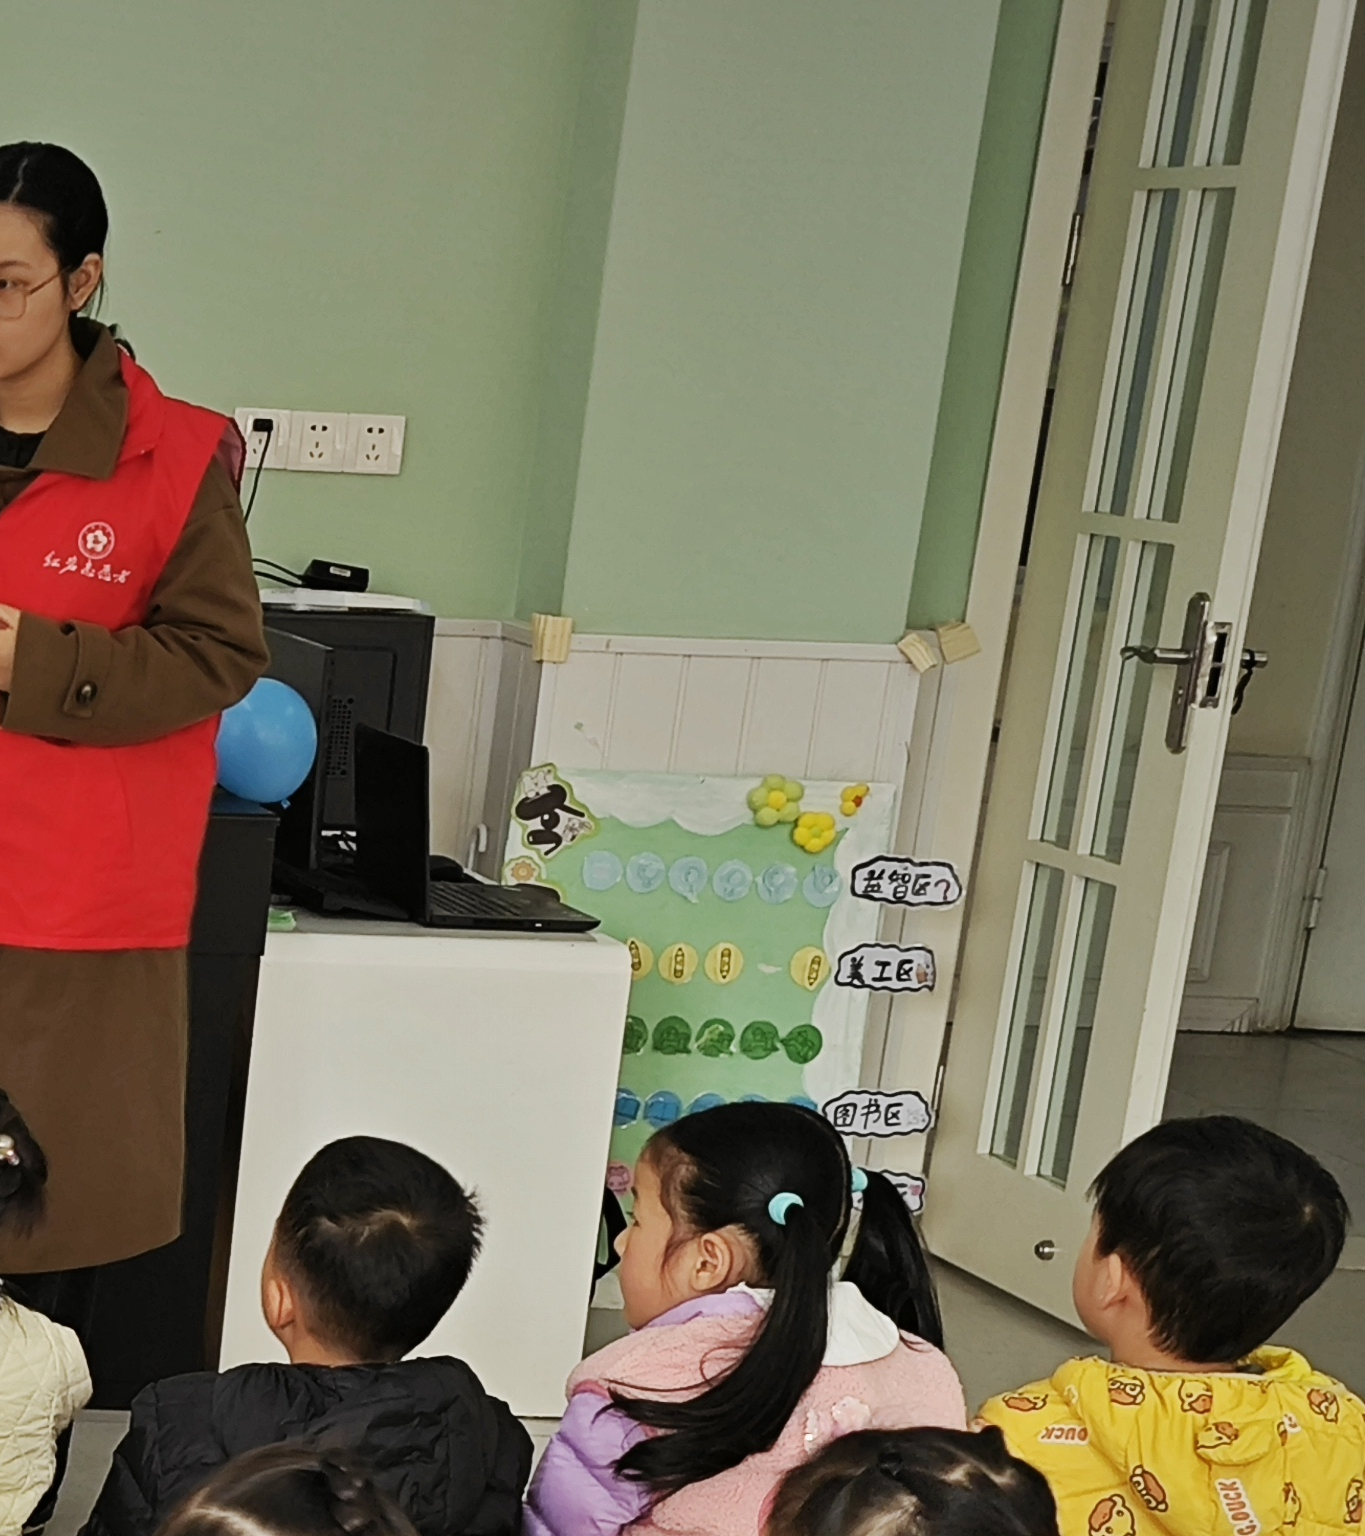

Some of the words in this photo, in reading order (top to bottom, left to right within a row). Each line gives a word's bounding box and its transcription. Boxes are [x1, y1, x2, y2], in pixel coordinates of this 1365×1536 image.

[846, 955, 915, 986] 美工区
[833, 1098, 904, 1130] 图书区
[1217, 1481, 1257, 1536] G.DUCK
